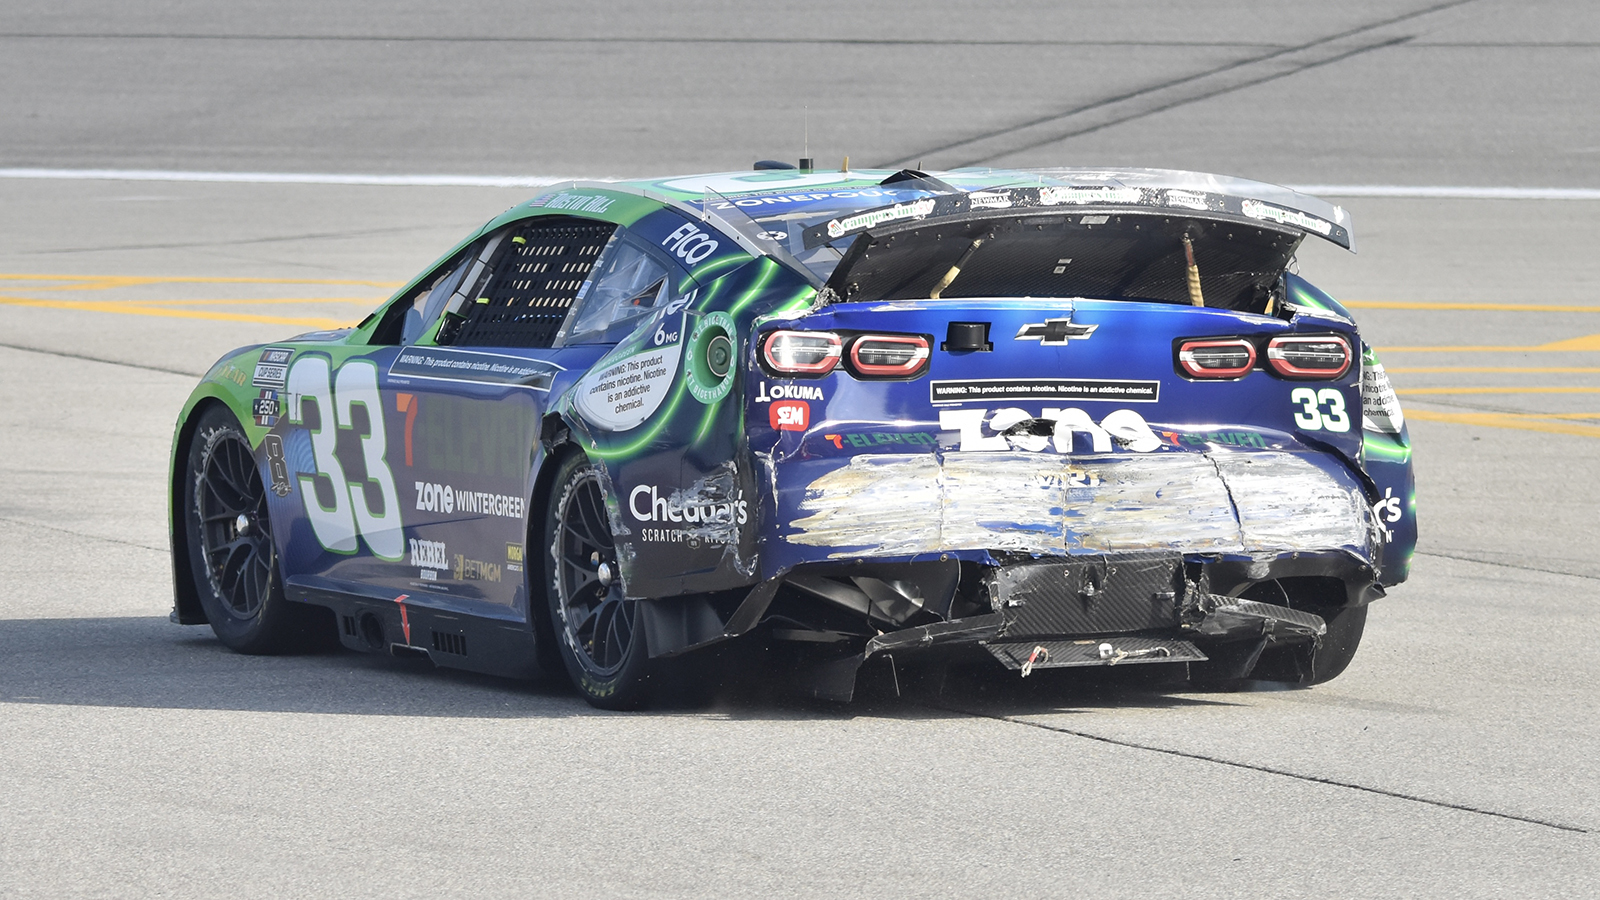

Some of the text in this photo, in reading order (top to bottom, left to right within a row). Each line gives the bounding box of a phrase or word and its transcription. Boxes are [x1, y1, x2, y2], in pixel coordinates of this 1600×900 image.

[971, 195, 1010, 206] NEWMAR
[662, 222, 719, 264] FICO
[654, 322, 679, 346] 6 MG
[704, 314, 736, 347] BIOETHANL
[258, 366, 283, 379] CUP SERIES
[399, 354, 424, 366] WARNING:
[423, 356, 435, 366] This
[431, 358, 454, 369] product
[451, 360, 472, 370] contains
[489, 362, 509, 373] Nicotine
[599, 364, 626, 381] WARNING:
[627, 360, 640, 372] This
[640, 355, 663, 370] product
[590, 367, 667, 395] contains nicotine. Nicotine
[692, 373, 733, 400] BIOETHANOL
[936, 385, 1153, 395] WARNING: This product contains nicotine. Nicotine is an addictive chemical.
[607, 384, 651, 403] is an addictive
[769, 385, 824, 401] OKUMA
[259, 399, 275, 415] 250
[614, 397, 644, 414] chemical.
[776, 406, 804, 425] SEM
[1290, 387, 1351, 433] 33
[1363, 408, 1395, 417] chemica
[286, 355, 405, 562] 33
[415, 481, 454, 514] zone
[641, 528, 683, 543] SCRATCH
[409, 538, 449, 571] REBEL
[465, 559, 501, 582] BETMGM
